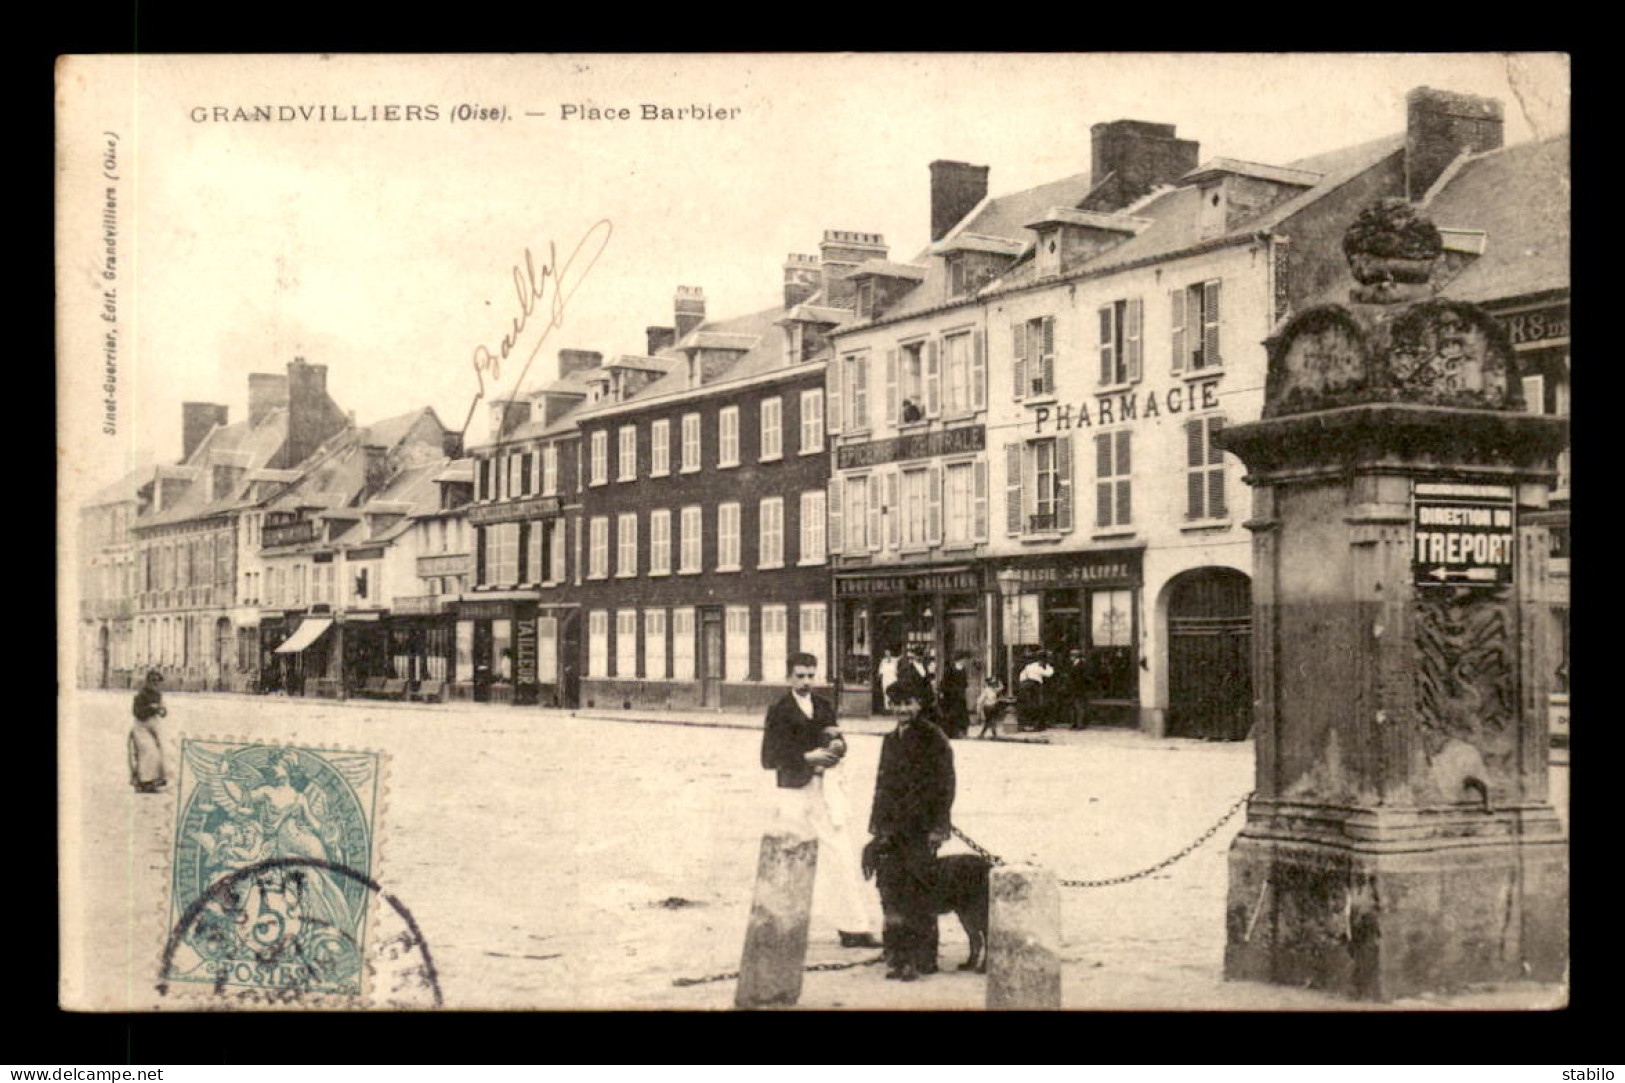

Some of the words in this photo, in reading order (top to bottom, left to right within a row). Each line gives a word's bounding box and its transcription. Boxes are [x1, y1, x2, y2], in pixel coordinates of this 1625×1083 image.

[1035, 381, 1219, 434] PHARMACIE
[1418, 506, 1492, 526] DIRECTION
[1416, 532, 1513, 565] TREPORT
[517, 618, 536, 686] TAILLEUR
[218, 960, 309, 987] POSTES
